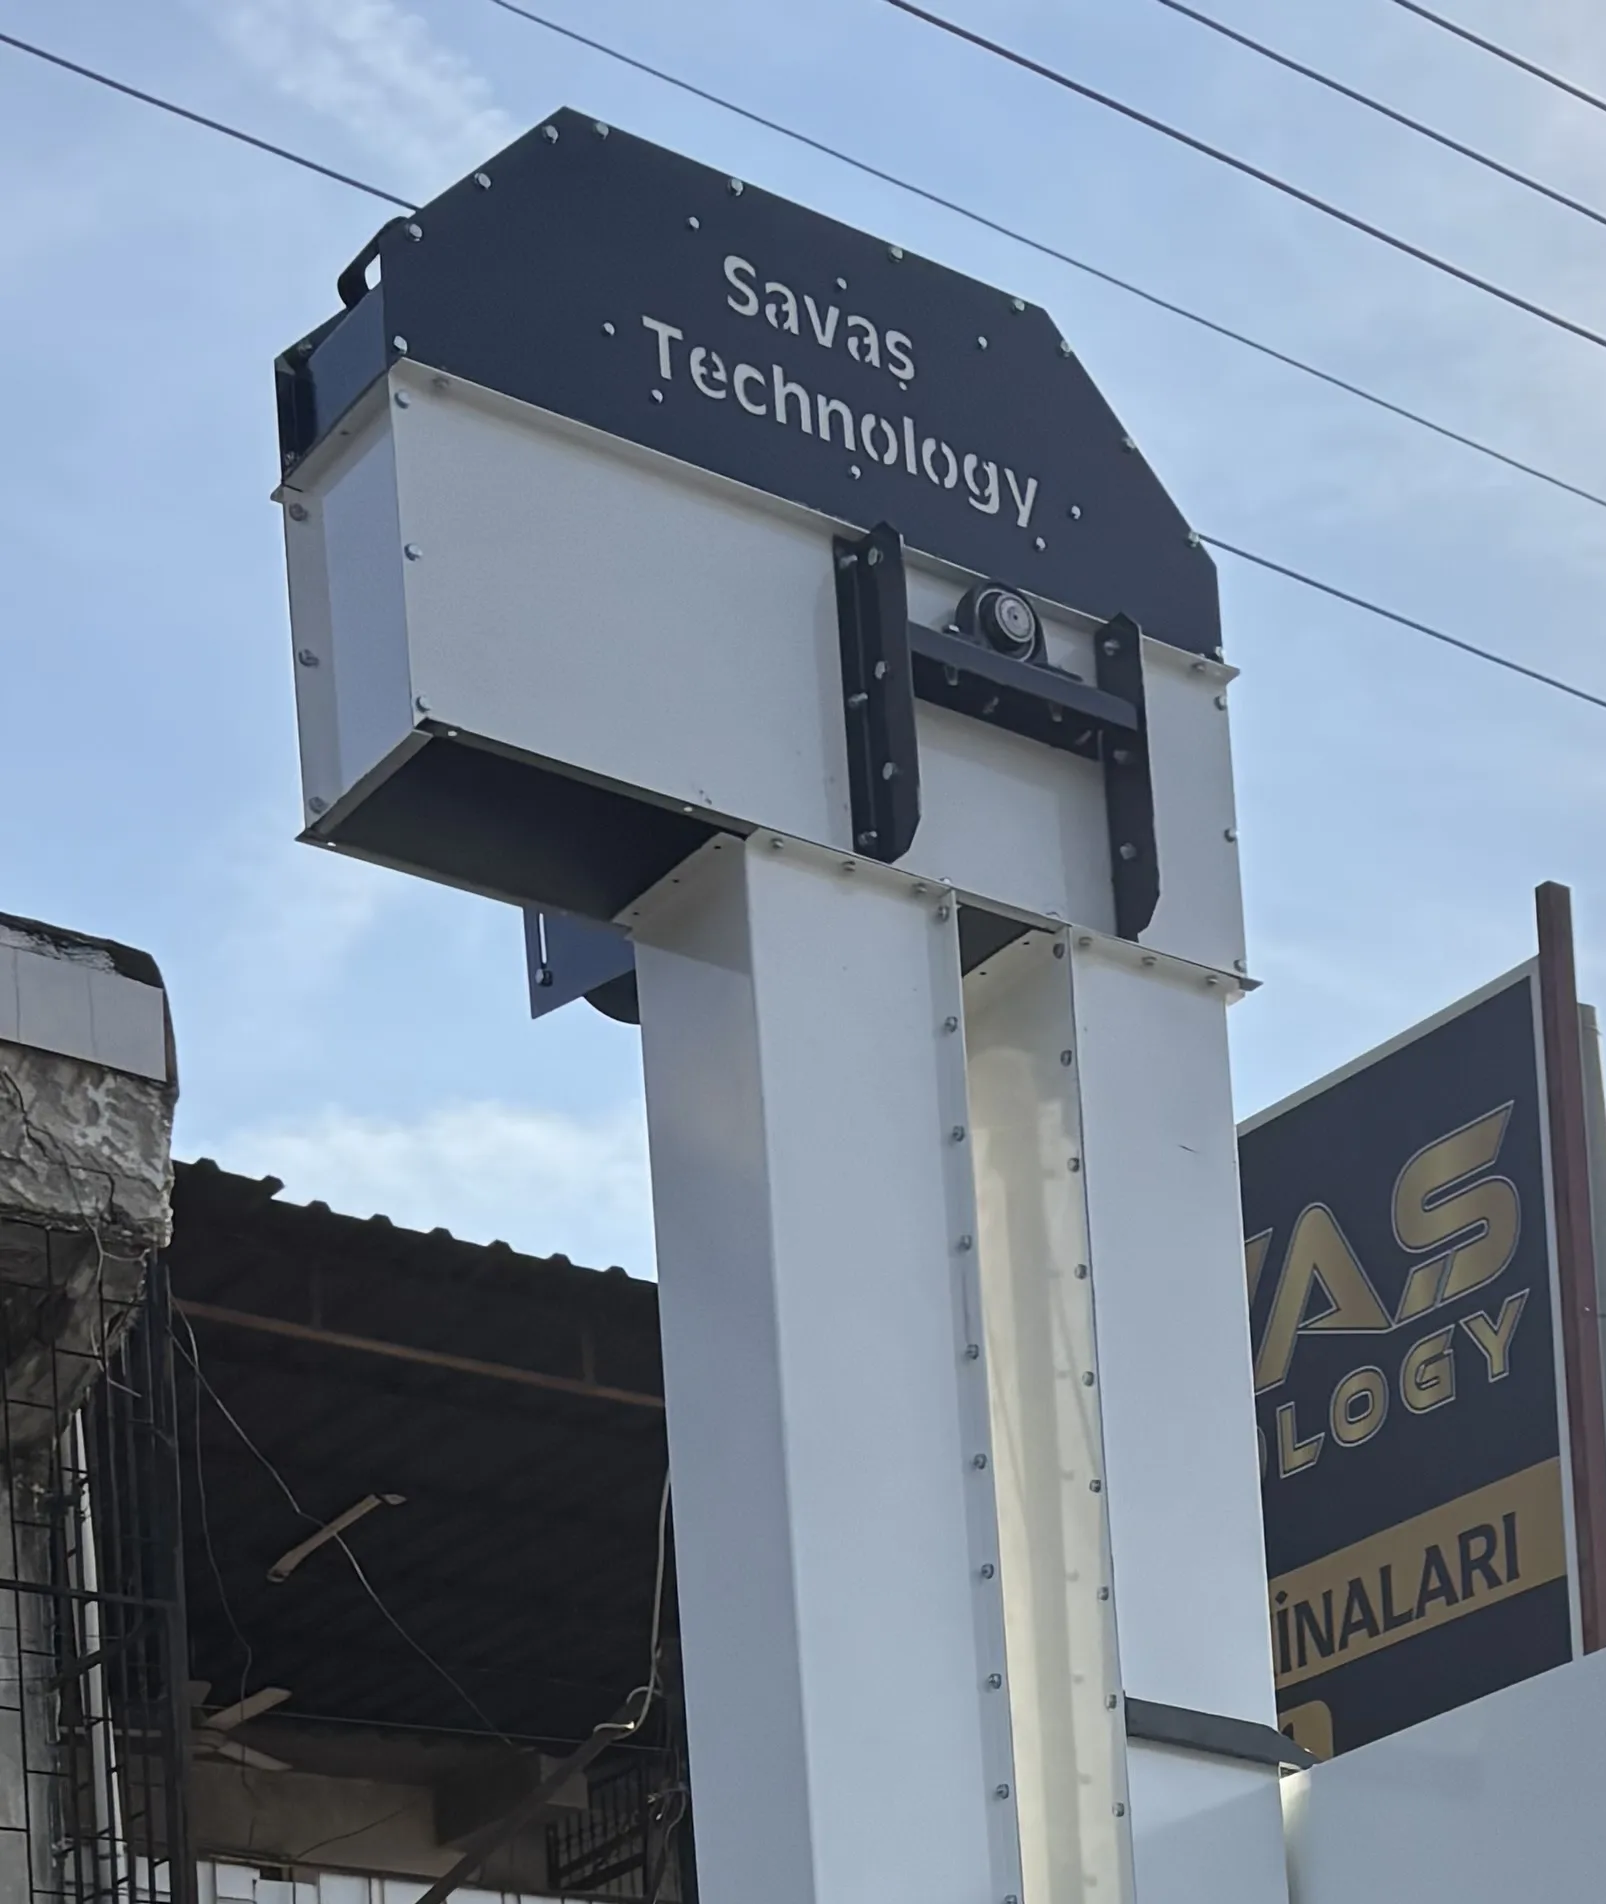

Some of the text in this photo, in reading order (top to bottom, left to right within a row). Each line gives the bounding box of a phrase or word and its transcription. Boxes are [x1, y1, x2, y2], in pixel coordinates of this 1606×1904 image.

[723, 254, 915, 390] Savaş
[641, 315, 1039, 528] Technology
[1244, 1099, 1522, 1395] AS
[1257, 1288, 1531, 1480] LOGY
[1270, 1511, 1521, 1675] İNALARI
